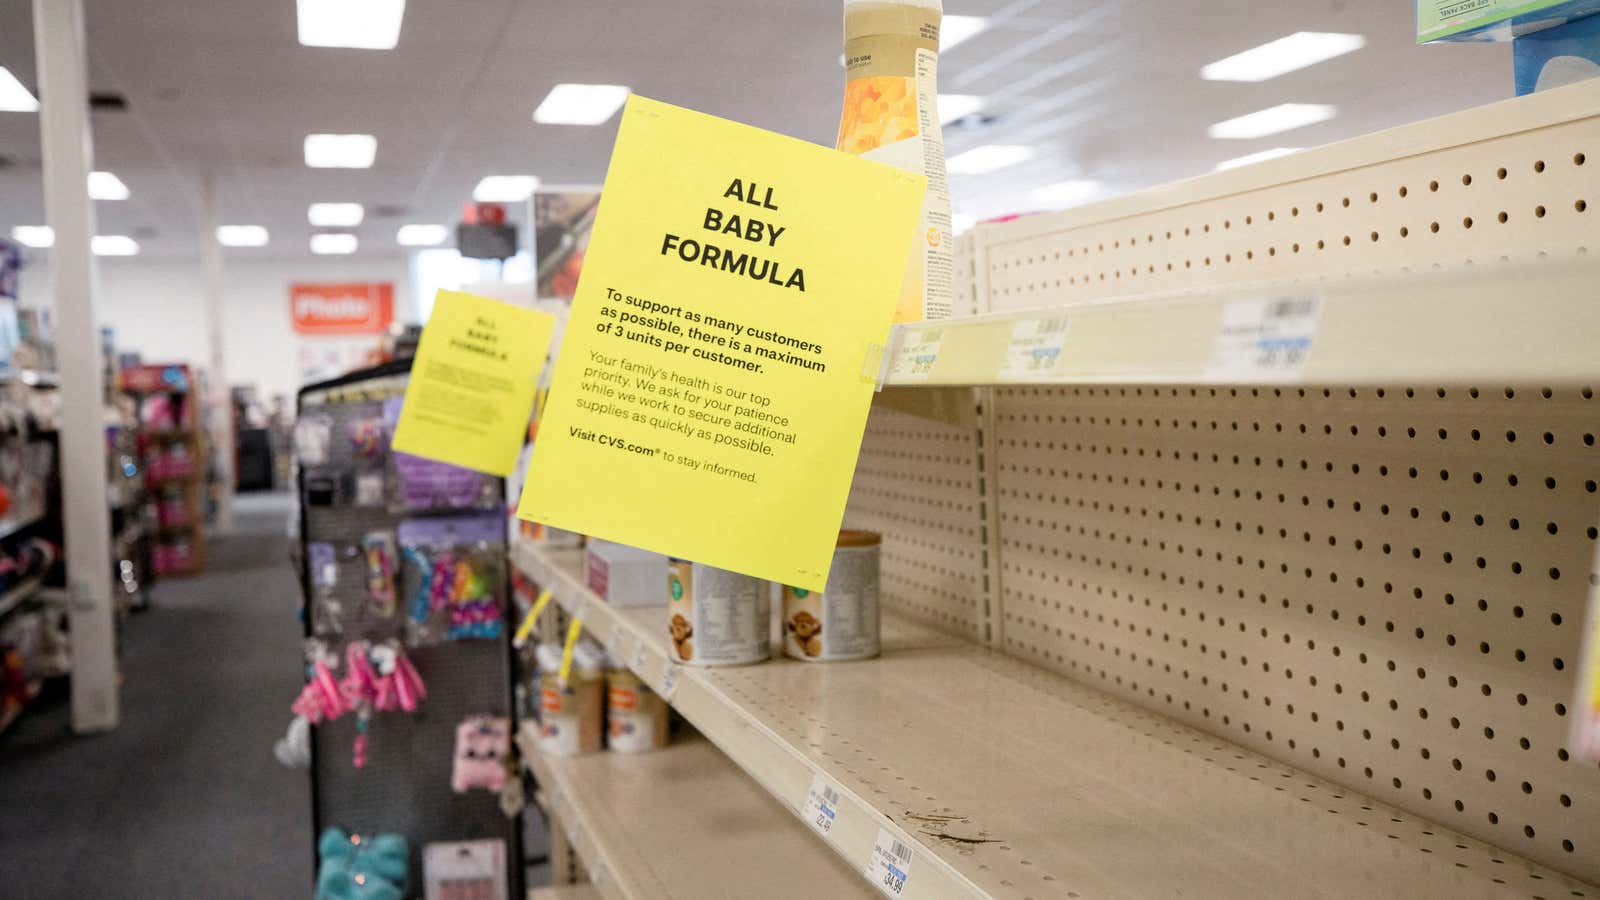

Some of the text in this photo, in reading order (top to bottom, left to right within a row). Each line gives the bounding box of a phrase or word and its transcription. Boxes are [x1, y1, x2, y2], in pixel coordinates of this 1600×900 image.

[1440, 5, 1458, 17] PANEL
[860, 53, 872, 62] use
[723, 178, 778, 212] ALL
[703, 208, 786, 248] BABY
[660, 233, 806, 292] FORMULA
[595, 321, 764, 375] of 3 units per customer.
[599, 306, 827, 373] as possible, there is a maximum
[605, 287, 823, 355] To support as many customers
[583, 367, 789, 427] priority. We ask for your patience
[590, 350, 619, 367] Your
[669, 370, 710, 391] health
[712, 385, 723, 395] is
[725, 388, 748, 401] our
[750, 392, 771, 408] top
[575, 398, 775, 457] supplies as quickly as possible.
[581, 382, 797, 445] while we work to secure additional
[569, 425, 597, 444] Visit
[663, 451, 675, 463] to
[677, 455, 701, 471] stay
[703, 463, 758, 484] informed.
